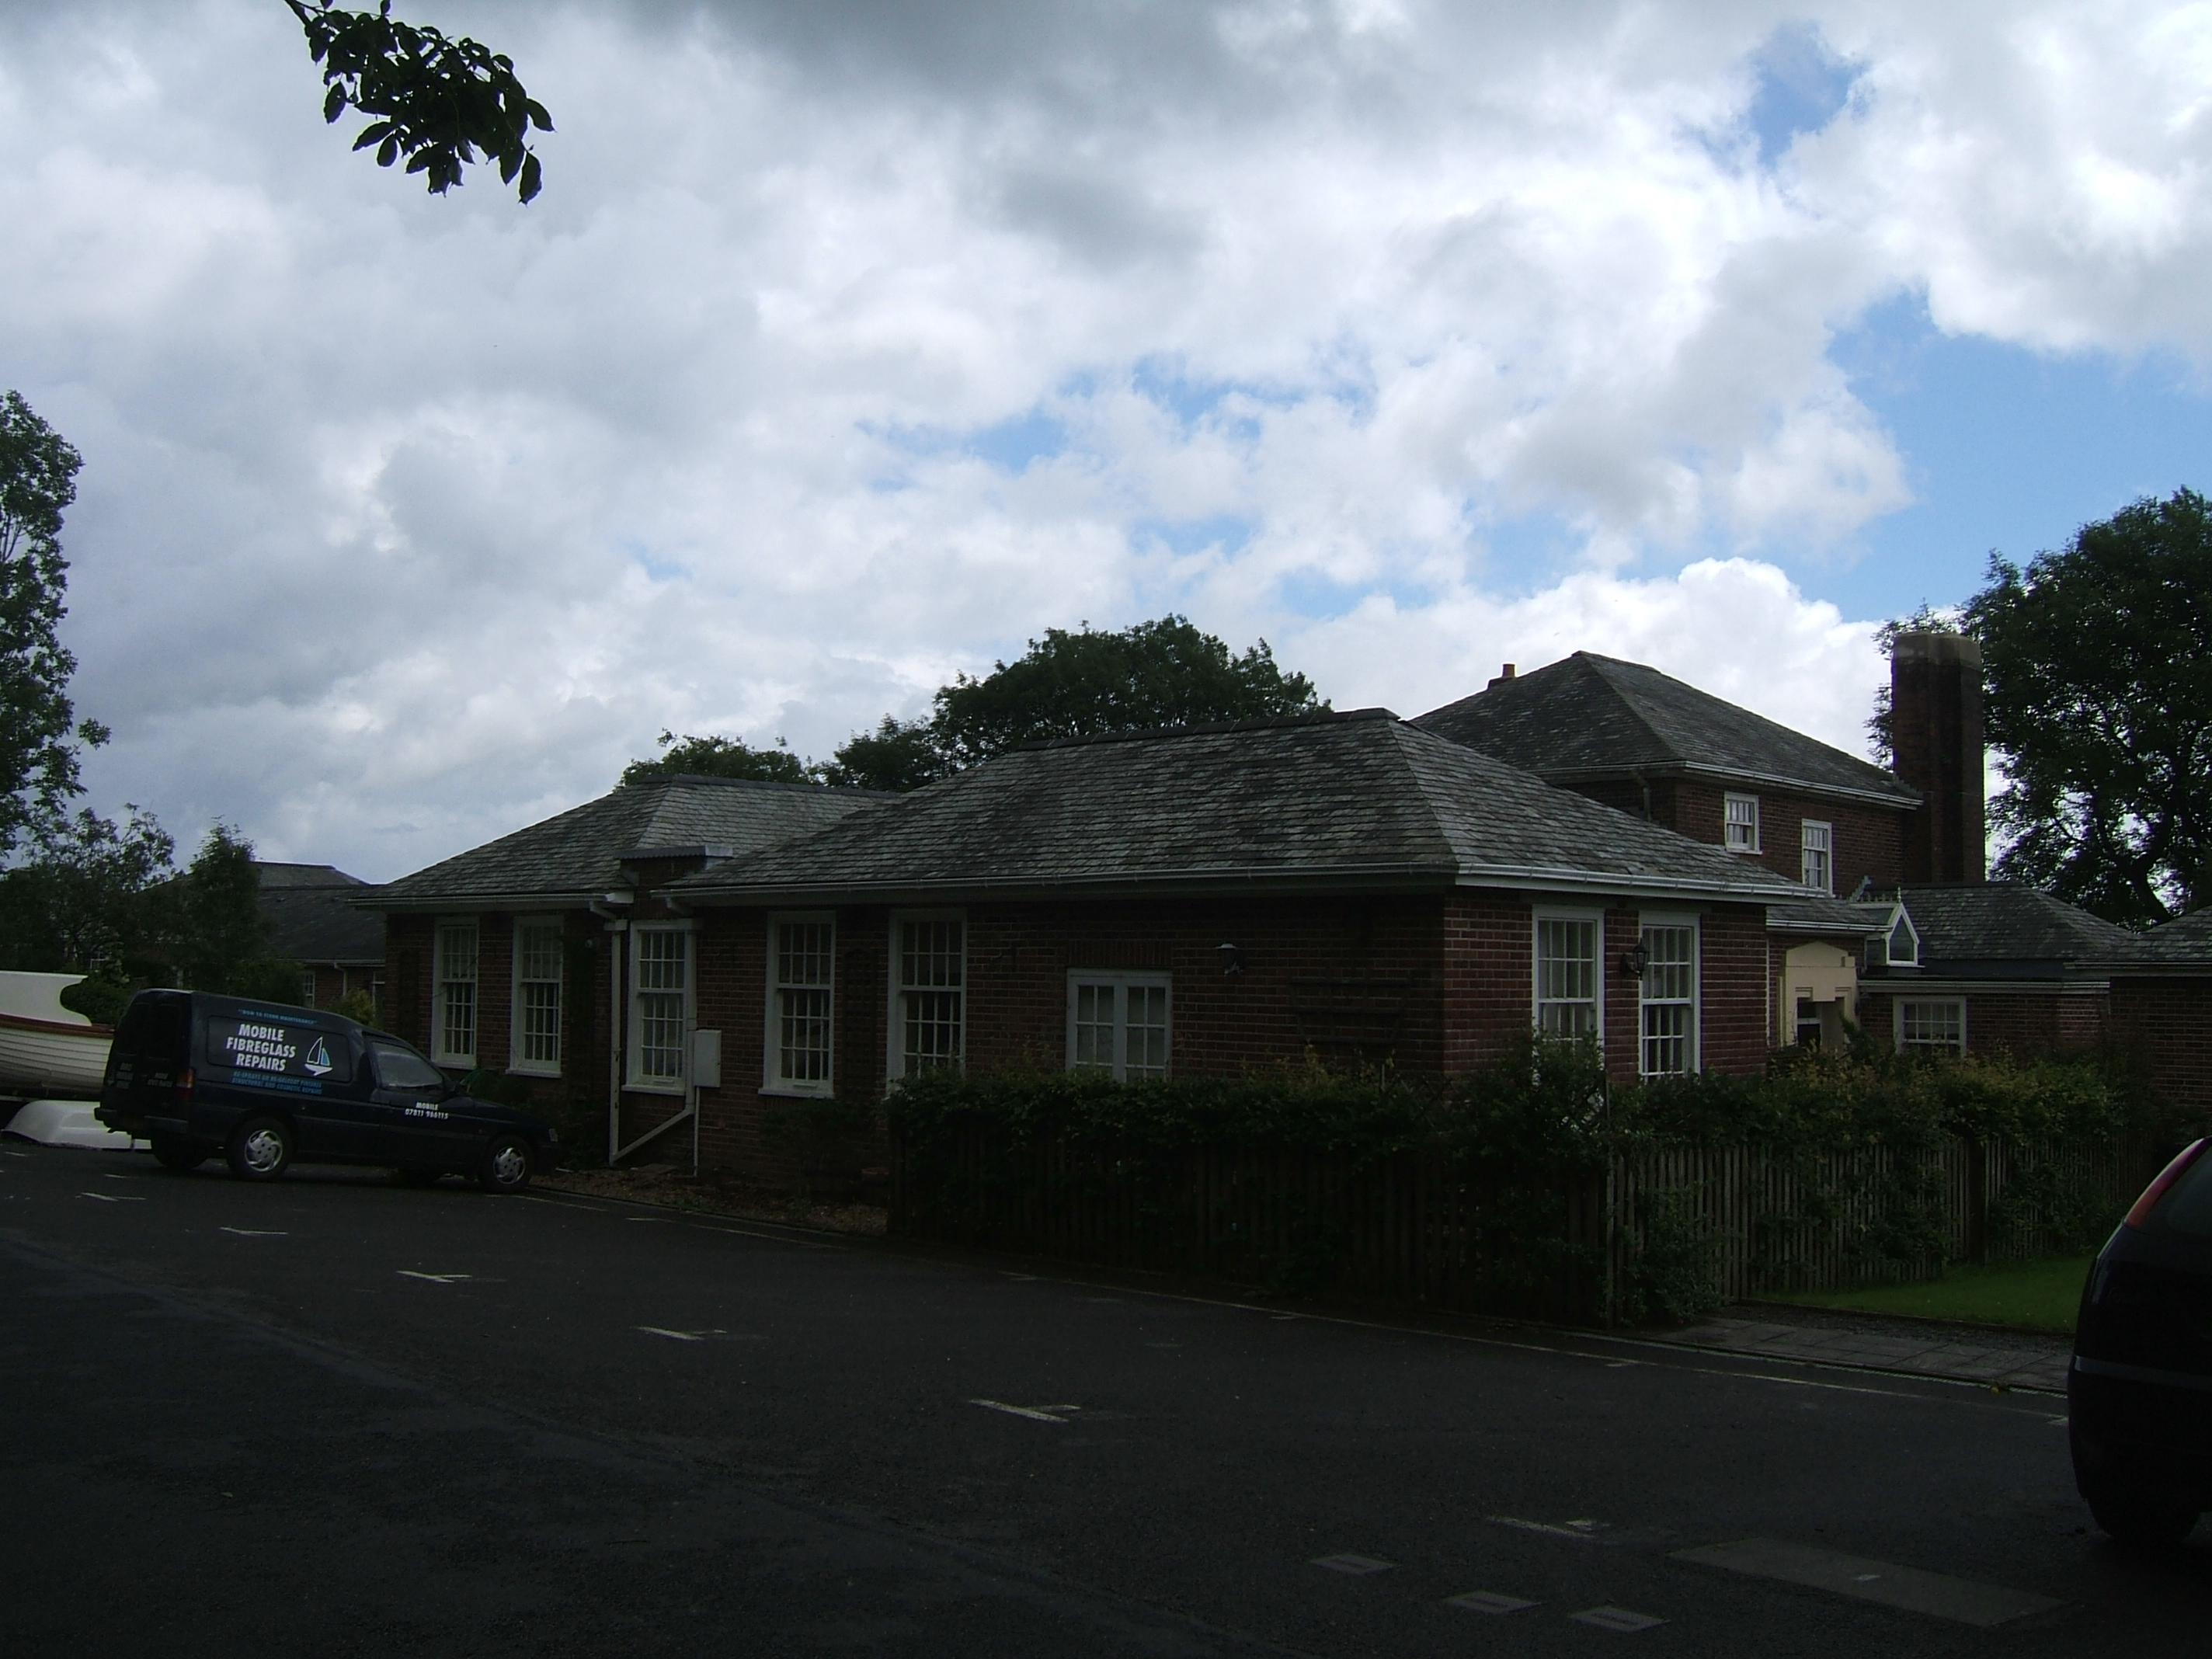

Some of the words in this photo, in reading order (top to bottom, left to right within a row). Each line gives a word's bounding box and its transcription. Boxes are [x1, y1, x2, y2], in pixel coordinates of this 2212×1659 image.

[238, 1023, 285, 1042] MOBILE
[226, 1036, 297, 1058] FIBREGLASS
[235, 1052, 287, 1071] REPAIRS
[416, 1102, 439, 1111] MOBILE
